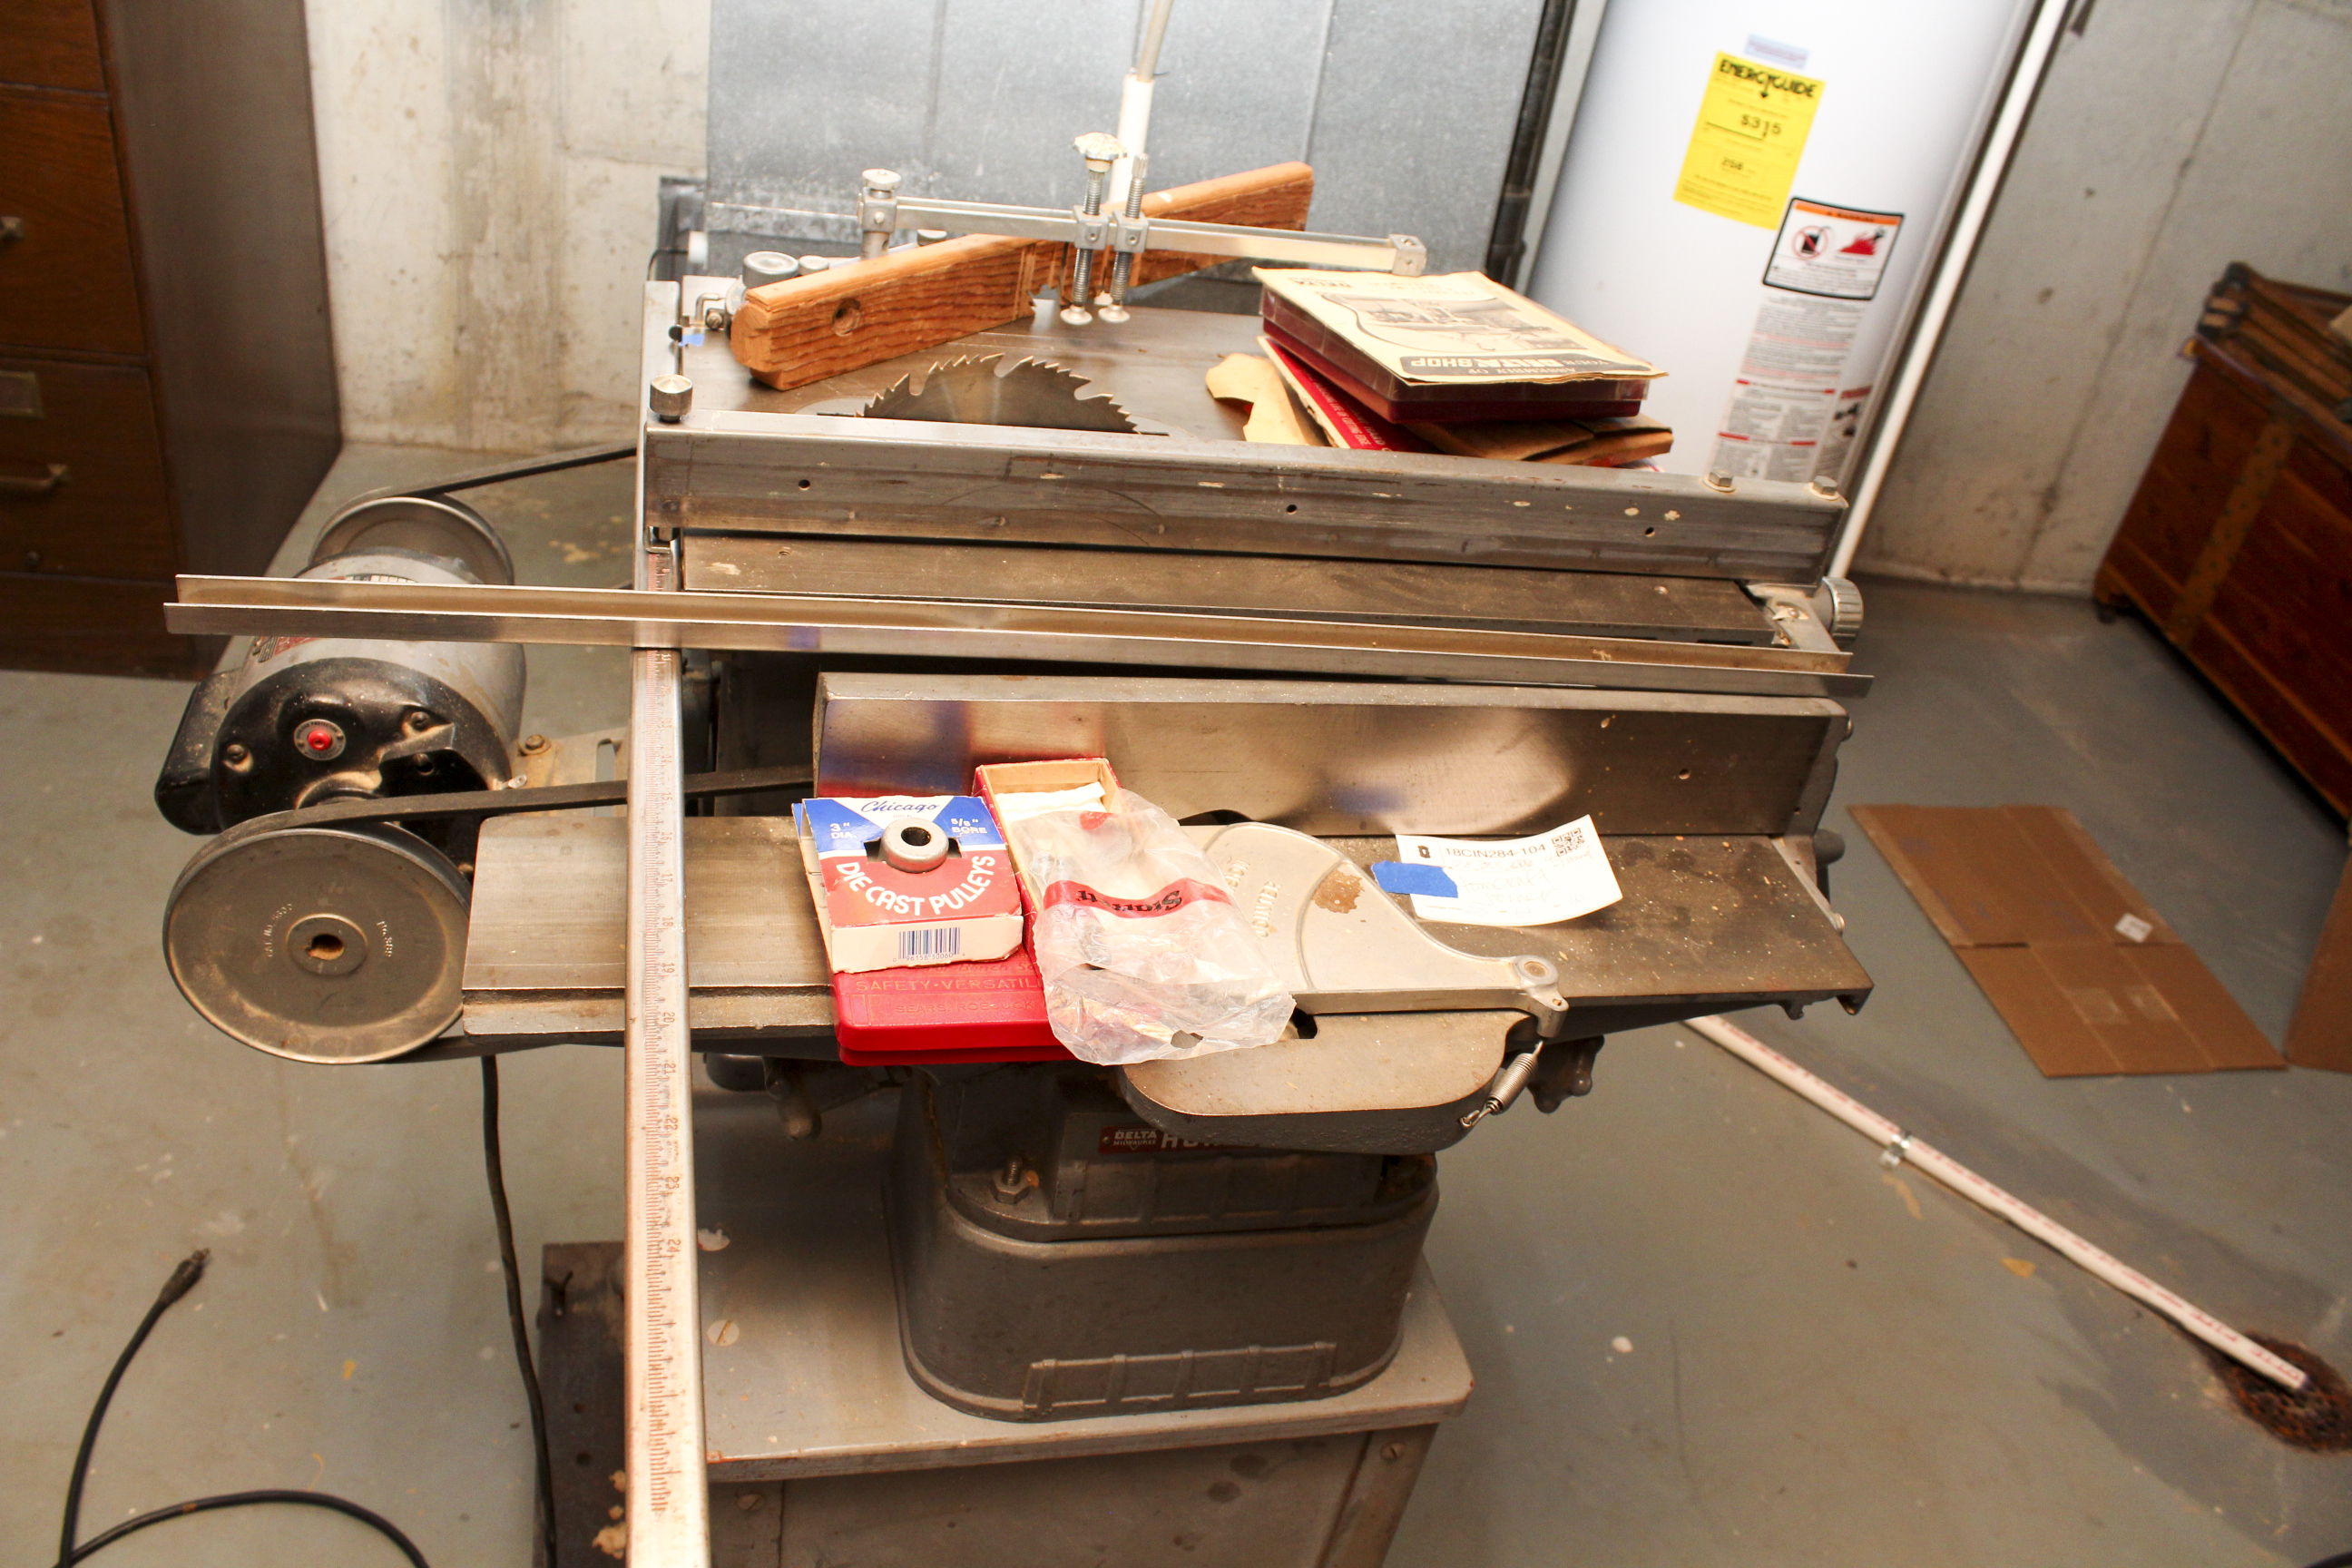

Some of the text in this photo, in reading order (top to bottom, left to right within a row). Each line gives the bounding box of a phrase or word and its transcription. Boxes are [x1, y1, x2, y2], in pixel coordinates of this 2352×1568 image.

[1410, 357, 1474, 368] SHOP
[860, 800, 941, 813] Chicago
[1446, 844, 1546, 858] 18CIN284-104
[837, 856, 995, 916] DIE CAST PULLEYS
[1252, 880, 1282, 939] JOINTER
[662, 962, 675, 974] 19
[957, 1000, 1034, 1012] ROEBUCK
[663, 1012, 676, 1024] 20
[663, 1063, 677, 1074] 21
[665, 1117, 678, 1131] 22
[1114, 1131, 1157, 1140] DELTA
[667, 1239, 681, 1253] 24
